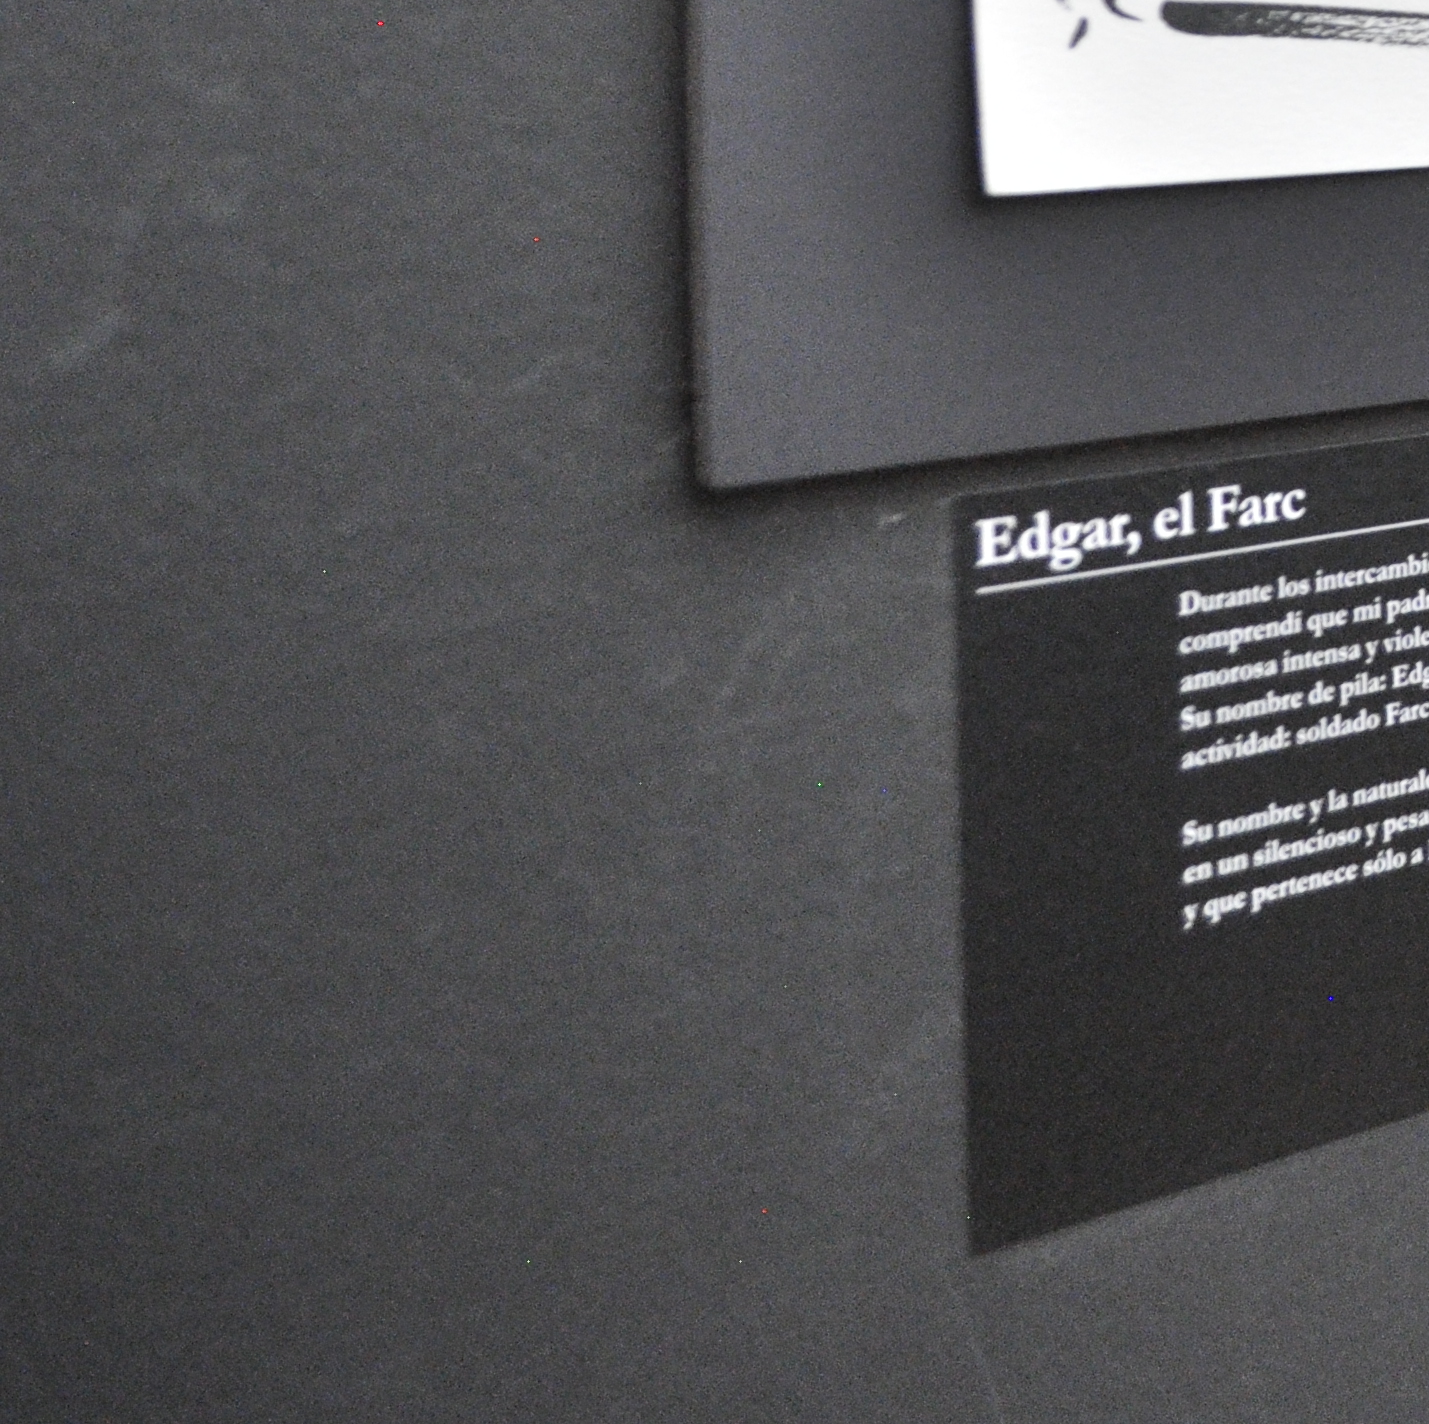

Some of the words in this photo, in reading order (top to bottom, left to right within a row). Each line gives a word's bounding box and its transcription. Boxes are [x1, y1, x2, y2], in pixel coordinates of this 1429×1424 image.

[974, 510, 1142, 568] Edgar,
[1152, 491, 1196, 539] el
[1206, 485, 1306, 532] Farc
[1177, 611, 1302, 654] comprendí
[1305, 609, 1348, 637] que
[1352, 597, 1381, 622] mi
[1178, 585, 1273, 616] Durante
[1277, 576, 1311, 598] los
[1179, 660, 1278, 692] amorosa
[1281, 644, 1361, 673] intensa
[1364, 640, 1378, 664] y
[1179, 706, 1212, 731] Su
[1215, 691, 1303, 723] nombre
[1307, 681, 1335, 705] de
[1339, 672, 1386, 706] pila:
[1180, 726, 1291, 769] actividad:
[1295, 709, 1381, 744] soldado
[1181, 820, 1214, 846] Su
[1216, 803, 1305, 837] nombre
[1308, 799, 1323, 823] y
[1327, 789, 1348, 812] la
[1181, 862, 1213, 884] en
[1216, 853, 1249, 875] un
[1251, 827, 1362, 866] silencioso
[1364, 823, 1378, 846] y
[1182, 904, 1198, 929] y
[1201, 892, 1247, 923] que
[1250, 864, 1358, 912] pertenece
[1361, 848, 1407, 876] sólo
[1410, 848, 1424, 864] a
